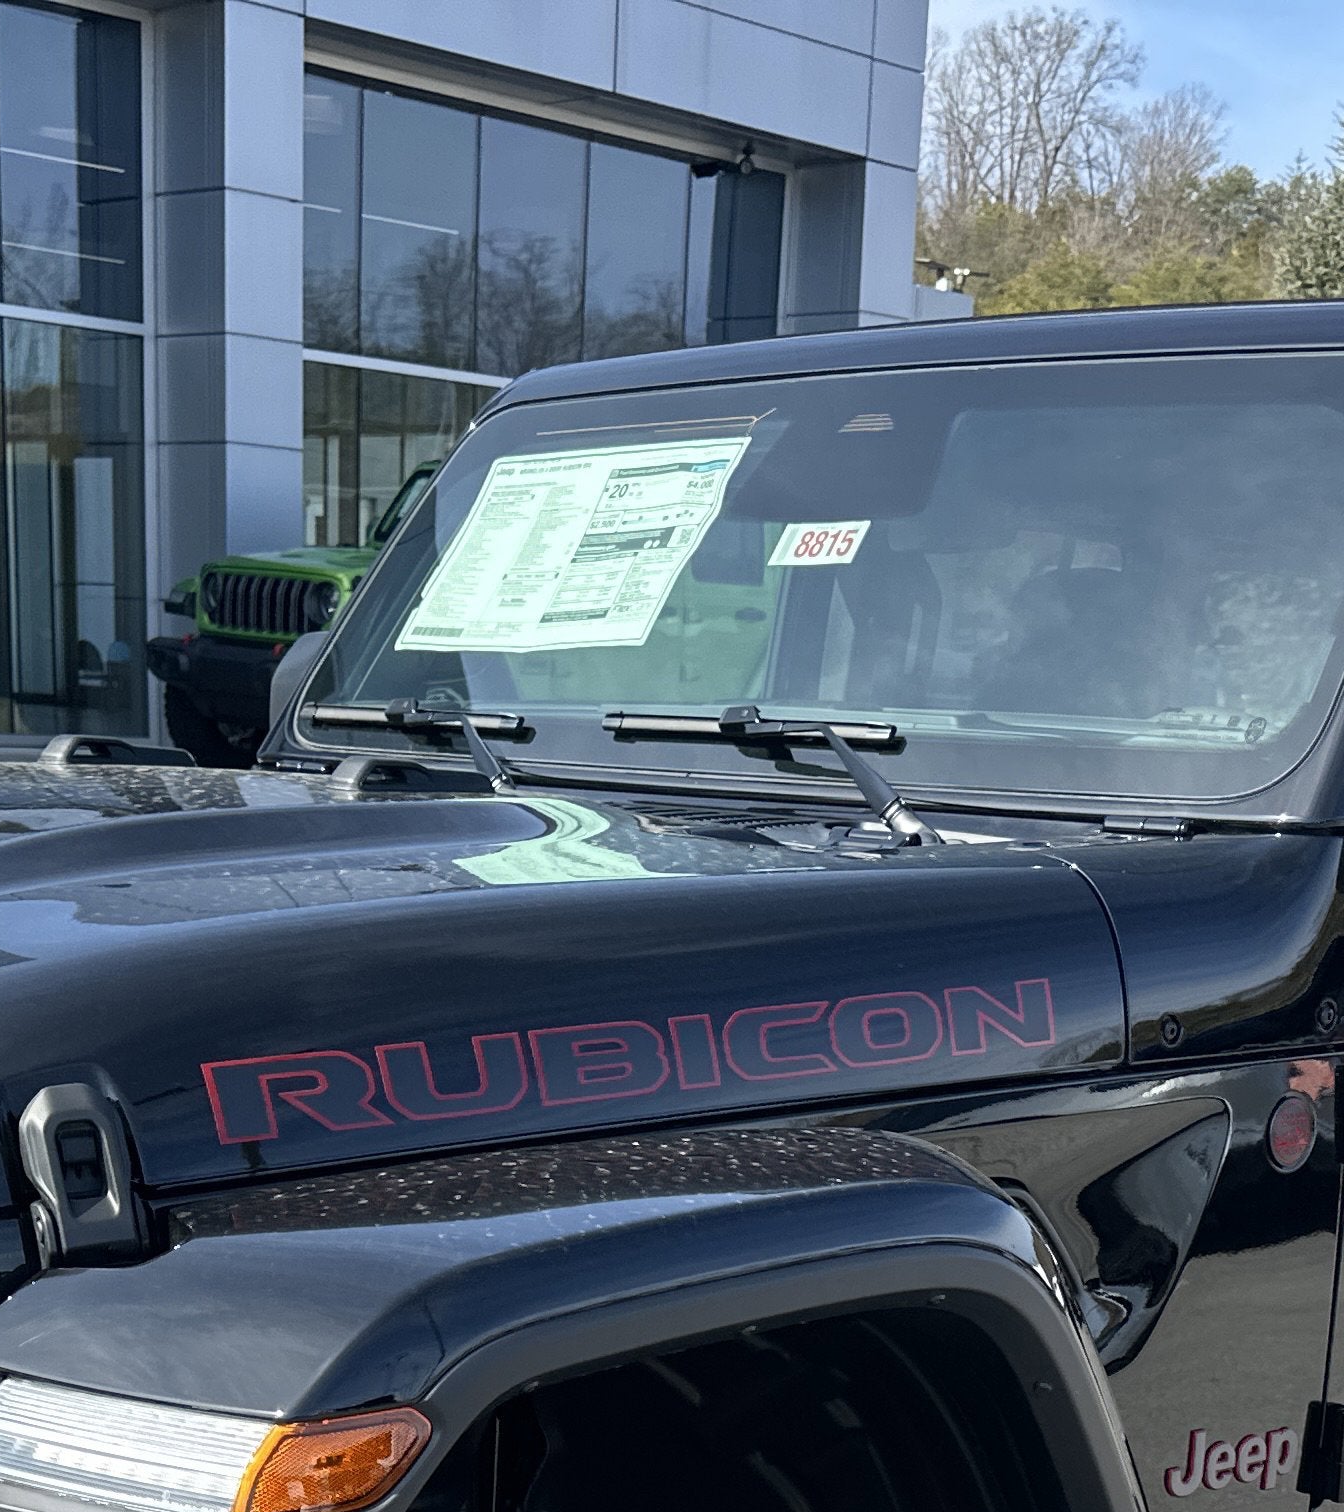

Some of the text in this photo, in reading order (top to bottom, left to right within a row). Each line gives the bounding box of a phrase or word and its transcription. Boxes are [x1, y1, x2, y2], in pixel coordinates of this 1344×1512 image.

[609, 485, 629, 498] 20
[794, 528, 859, 558] 8815
[201, 978, 1055, 1146] RUBICON
[1164, 1426, 1298, 1497] Jeep
